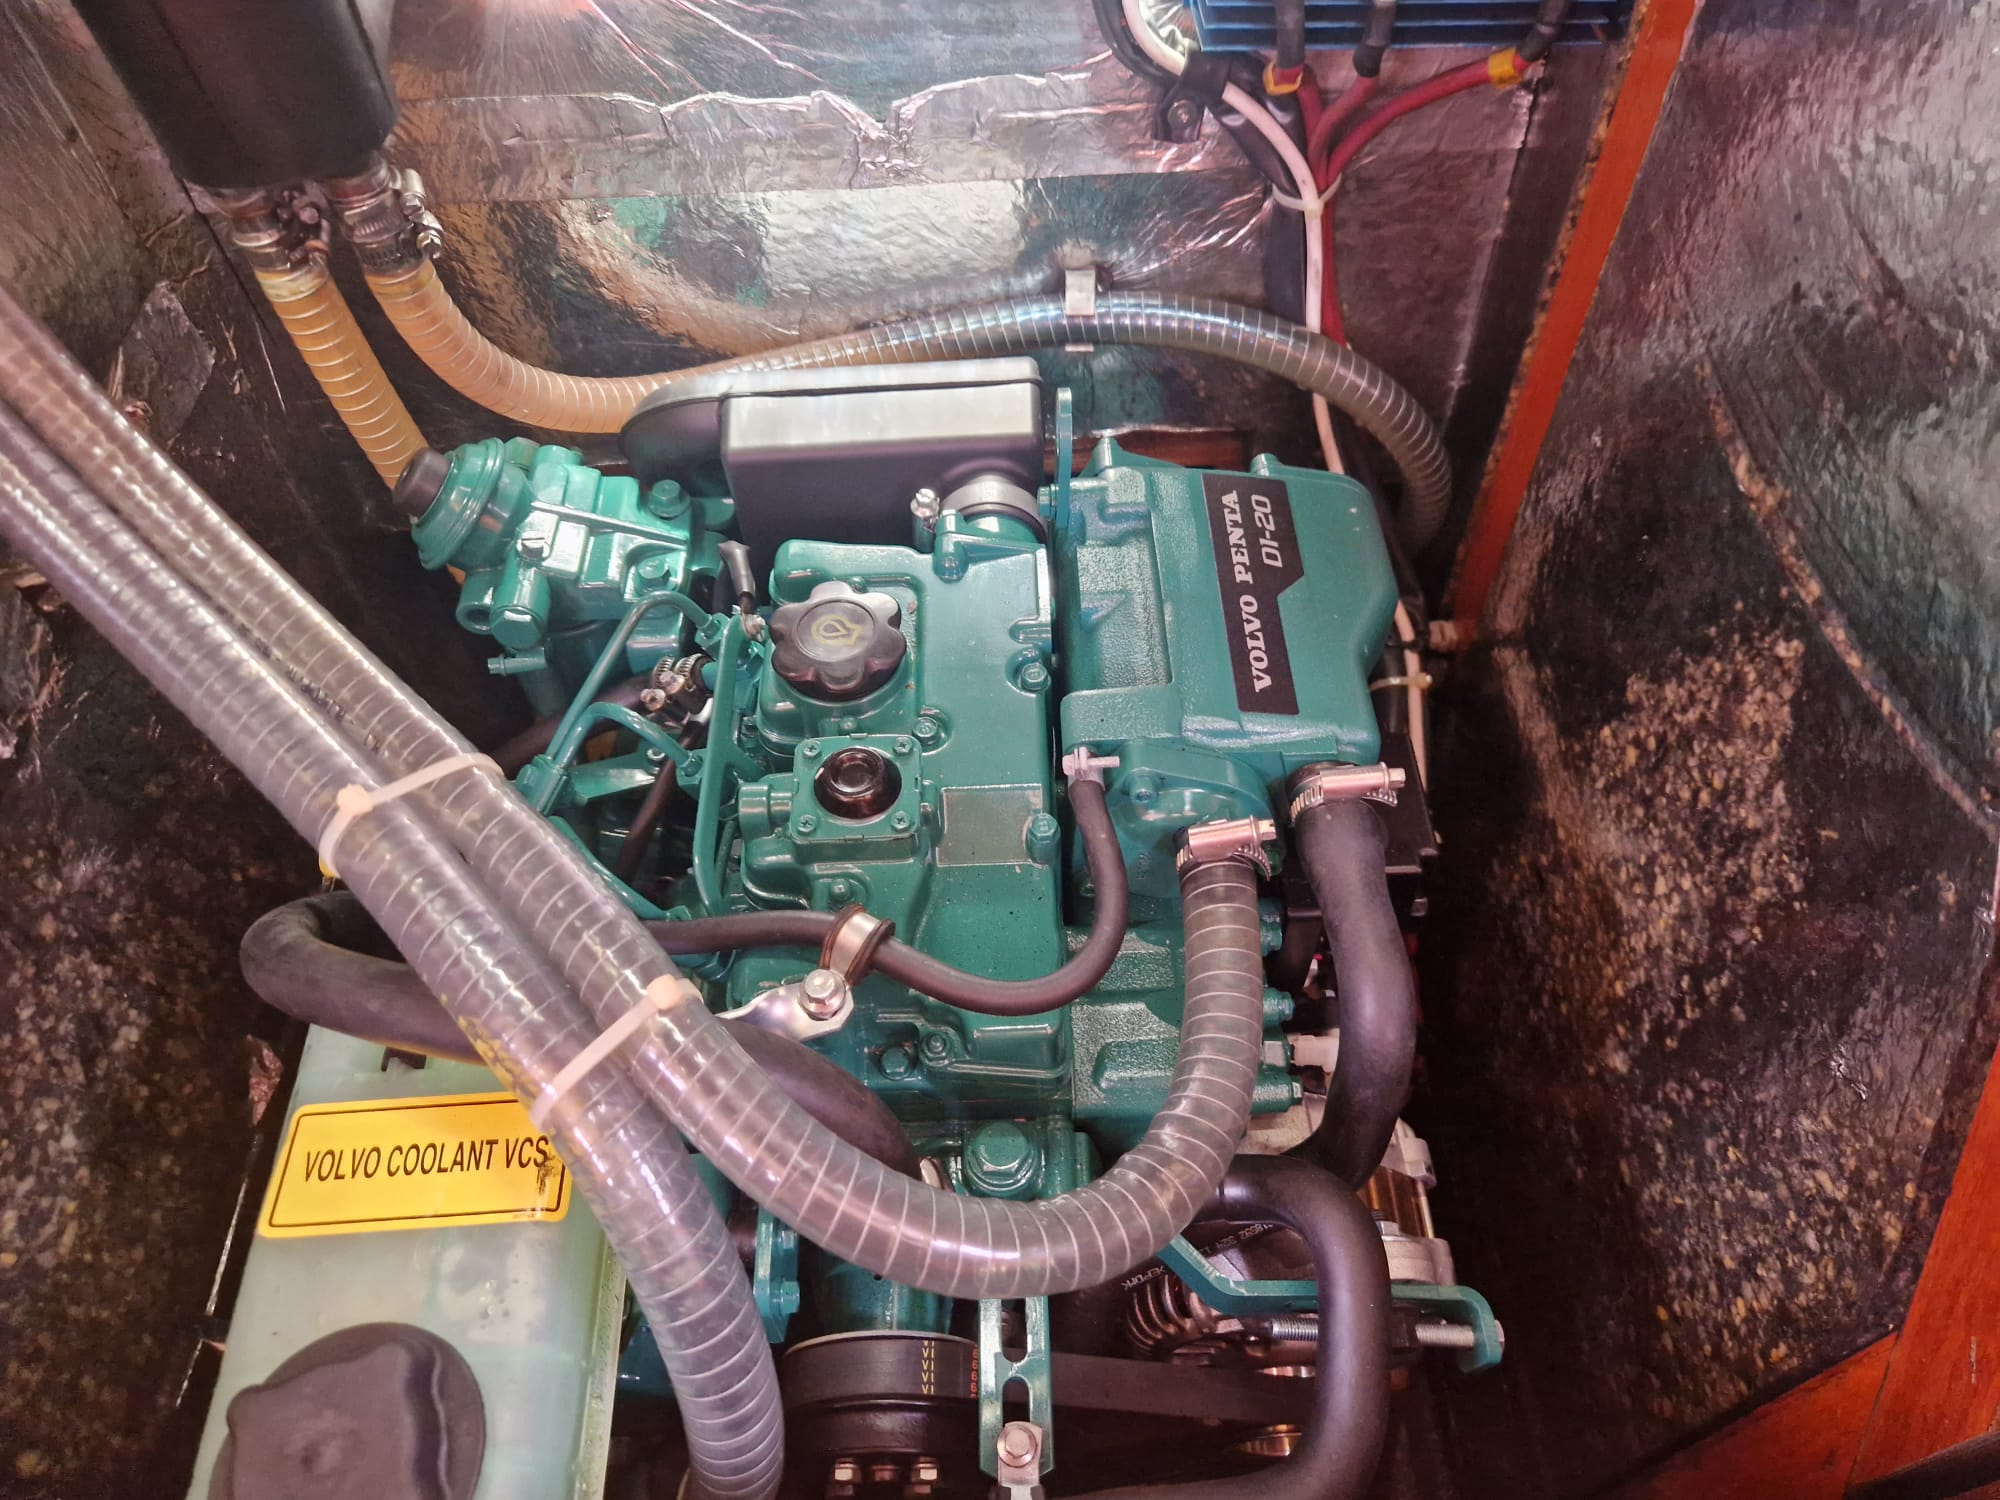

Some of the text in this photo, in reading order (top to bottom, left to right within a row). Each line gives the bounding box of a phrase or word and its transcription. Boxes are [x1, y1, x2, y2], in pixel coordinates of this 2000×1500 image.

[1221, 490, 1273, 693] VOLVO PENTA
[304, 1135, 550, 1183] VOLVO COOLANT VCS
